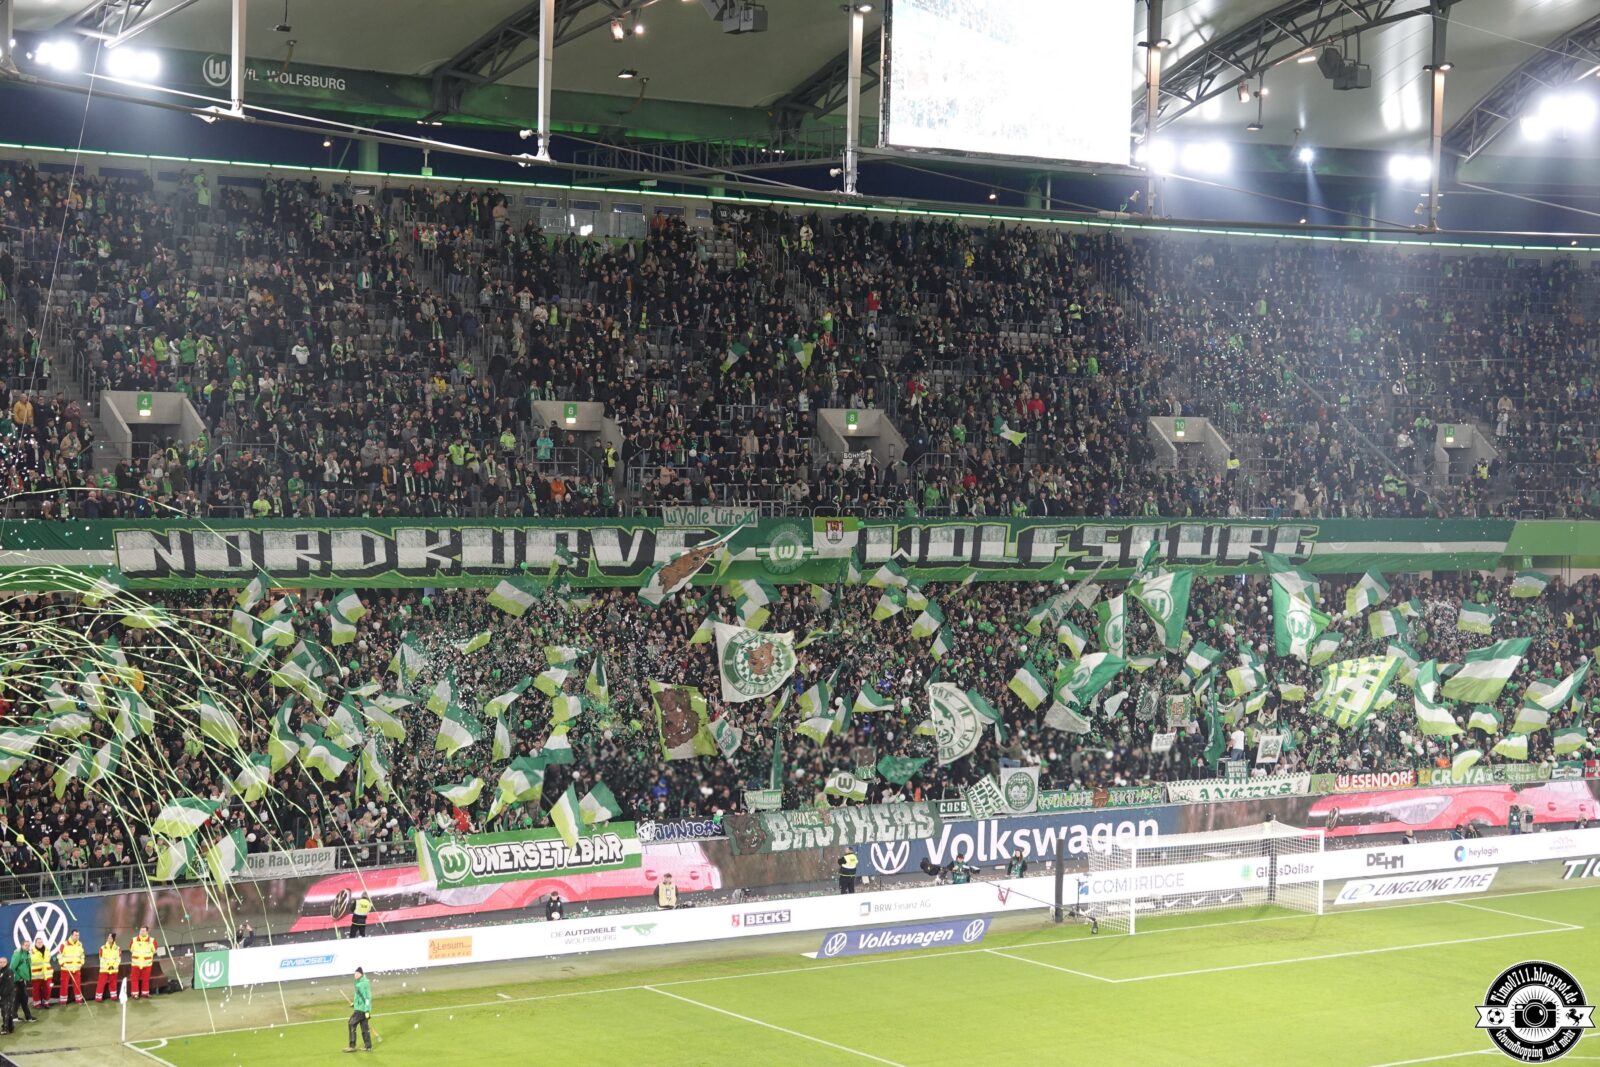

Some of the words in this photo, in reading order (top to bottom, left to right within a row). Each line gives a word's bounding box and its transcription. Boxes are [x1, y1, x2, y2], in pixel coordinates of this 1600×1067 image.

[266, 70, 346, 91] WOLFSBURG
[1175, 421, 1185, 429] 10
[866, 523, 1319, 571] WOLFSBURG
[926, 819, 1159, 865] Volkswagen
[1468, 845, 1499, 858] heylogin
[471, 834, 623, 876] UNERSETZBAR
[1374, 876, 1452, 896] LINGLONG
[1452, 873, 1492, 889] TIRE
[874, 903, 892, 913] BRW
[858, 928, 954, 950] Volkswagen
